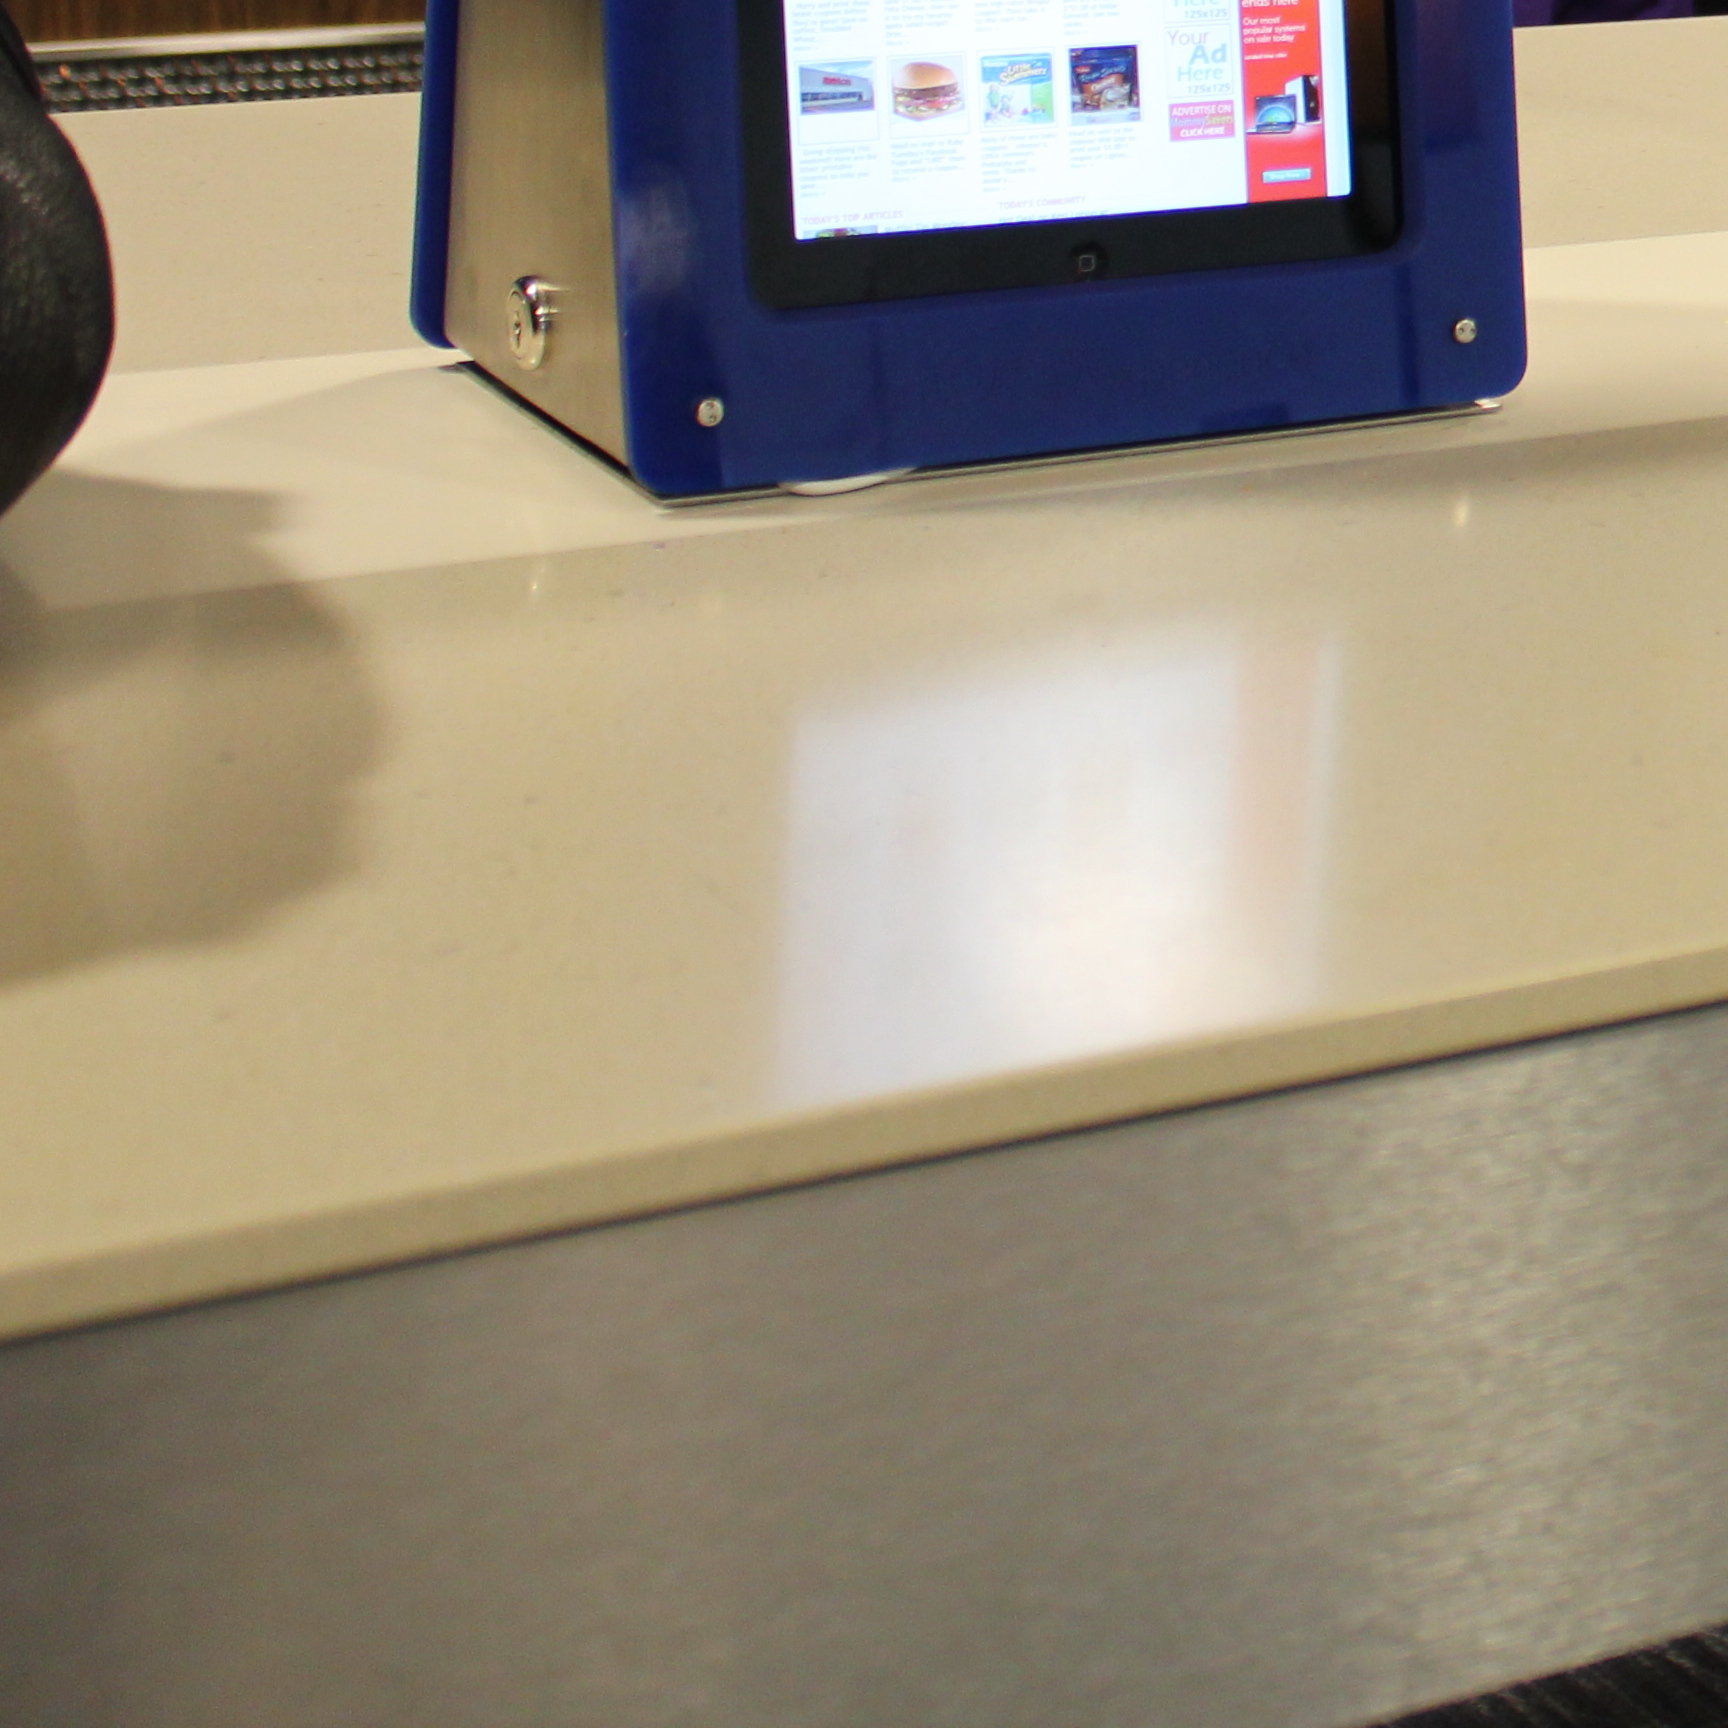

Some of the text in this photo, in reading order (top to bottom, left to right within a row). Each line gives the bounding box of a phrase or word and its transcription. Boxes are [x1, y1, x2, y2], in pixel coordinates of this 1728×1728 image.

[1184, 7, 1228, 19] 125x125
[1167, 29, 1210, 46] Your
[1188, 42, 1228, 66] Ad
[1176, 66, 1224, 83] Here
[1188, 82, 1231, 95] 125x125
[1171, 104, 1232, 117] ADVERTISE ON
[1179, 126, 1226, 138] CLICK HERE
[998, 200, 1034, 210] TODAY'S
[803, 214, 840, 225] TODAY'S
[841, 213, 860, 223] TOP
